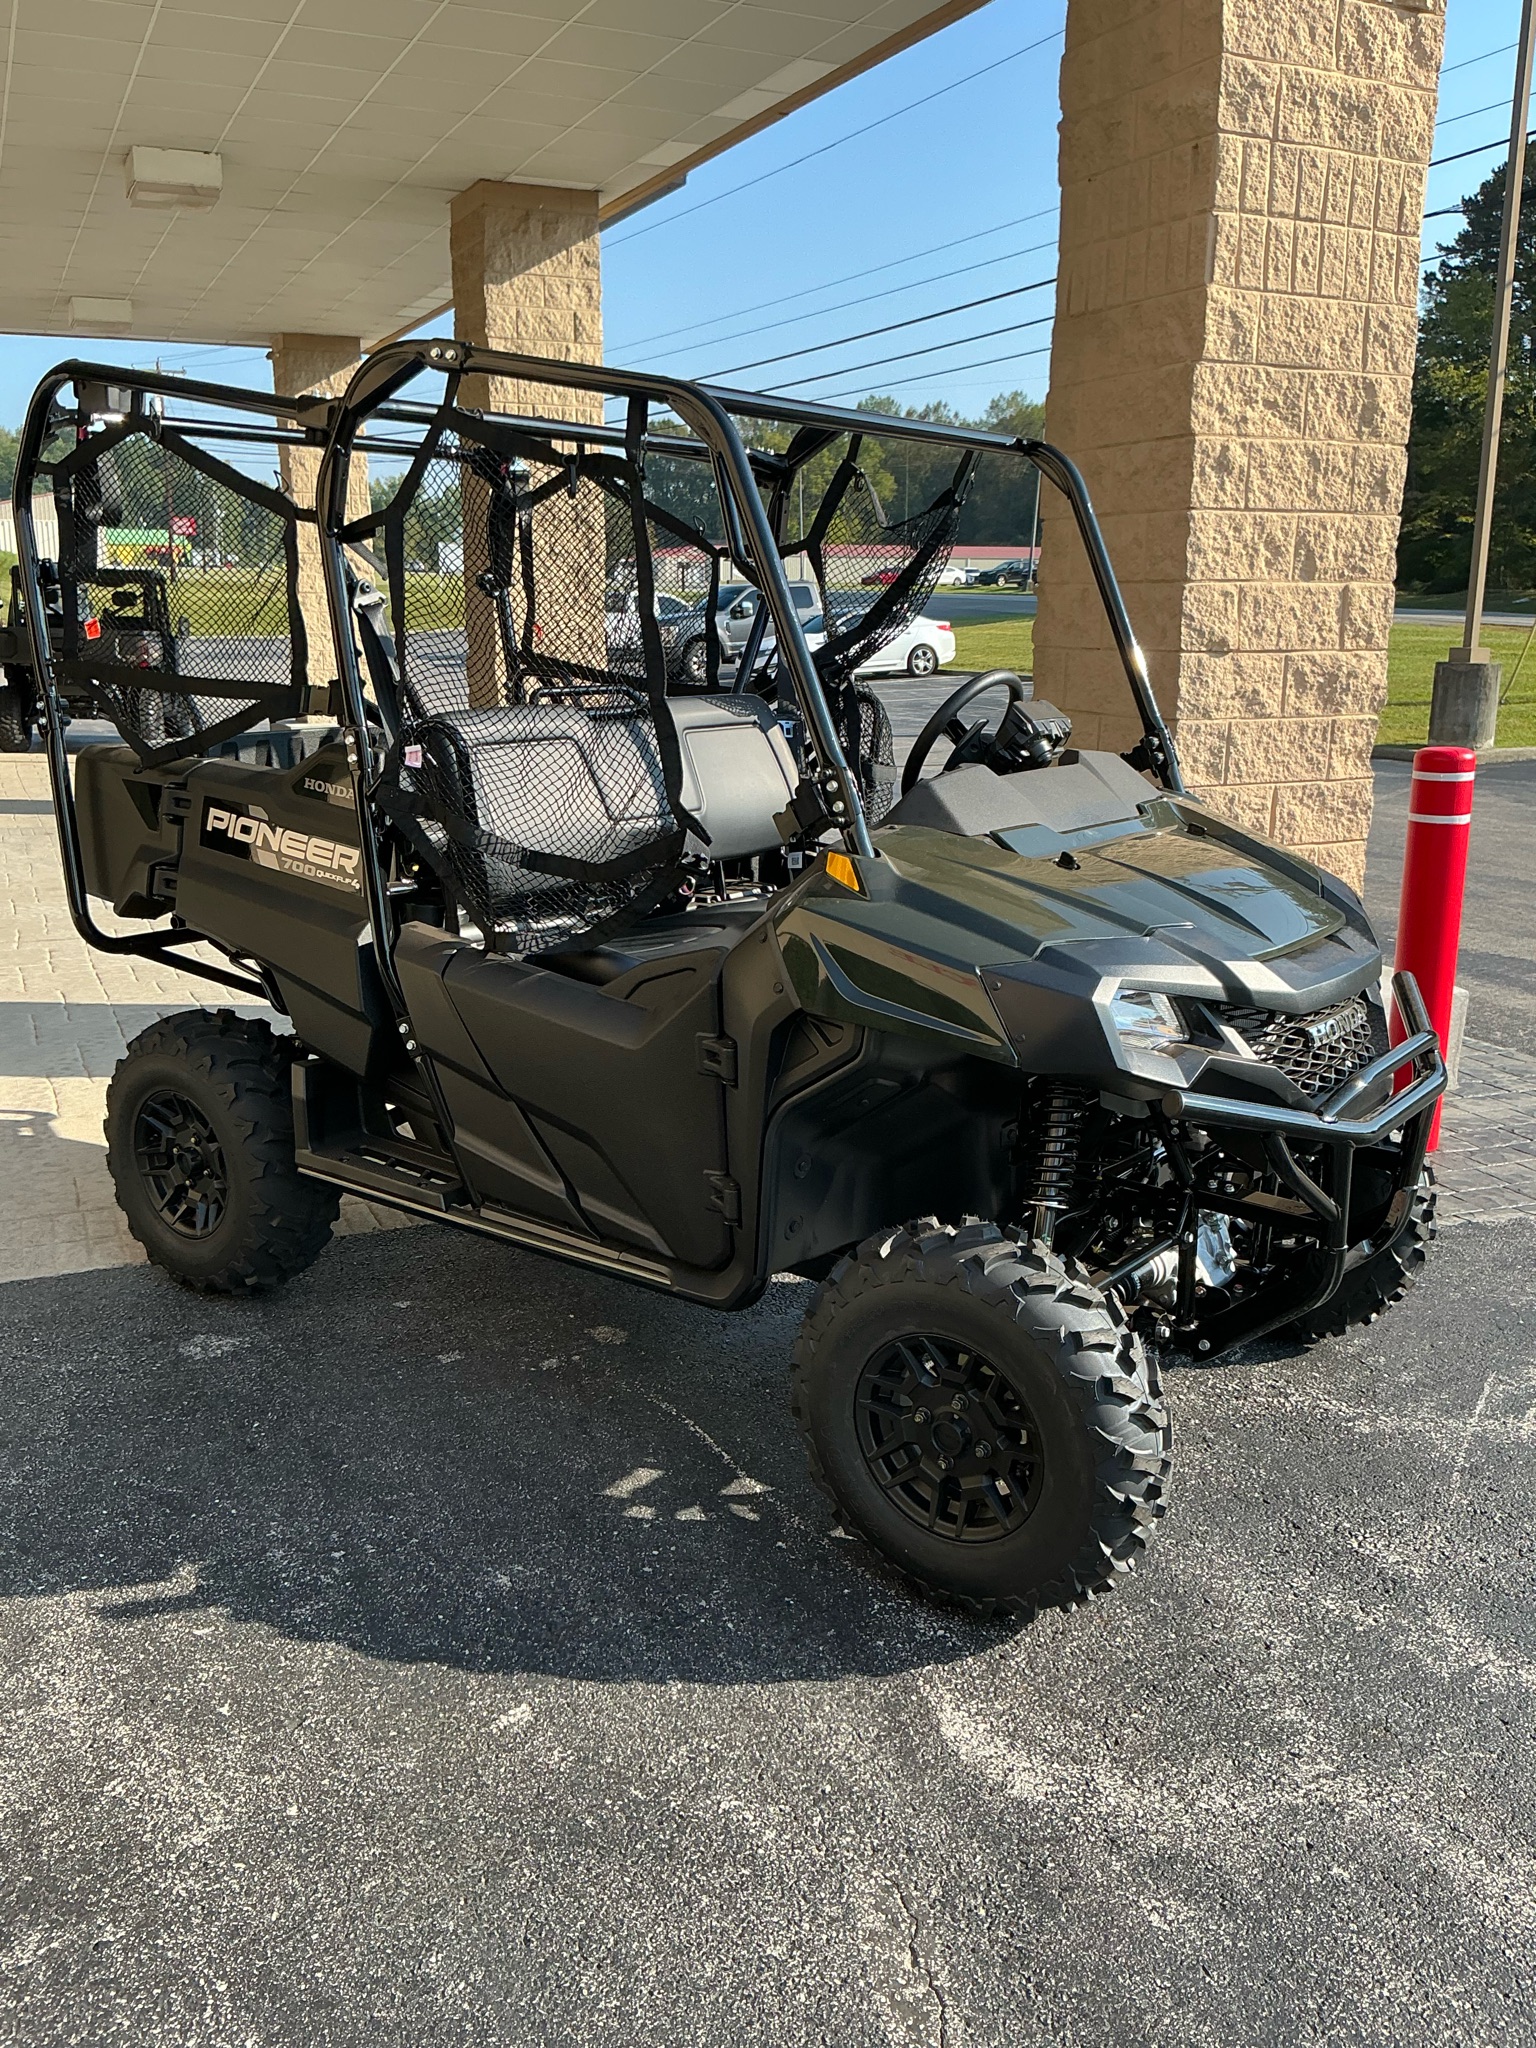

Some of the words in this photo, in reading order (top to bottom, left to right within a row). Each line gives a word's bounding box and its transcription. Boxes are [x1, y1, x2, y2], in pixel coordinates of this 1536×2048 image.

[303, 777, 354, 800] HONDA
[206, 807, 360, 874] PIONEER
[281, 857, 316, 877] 700
